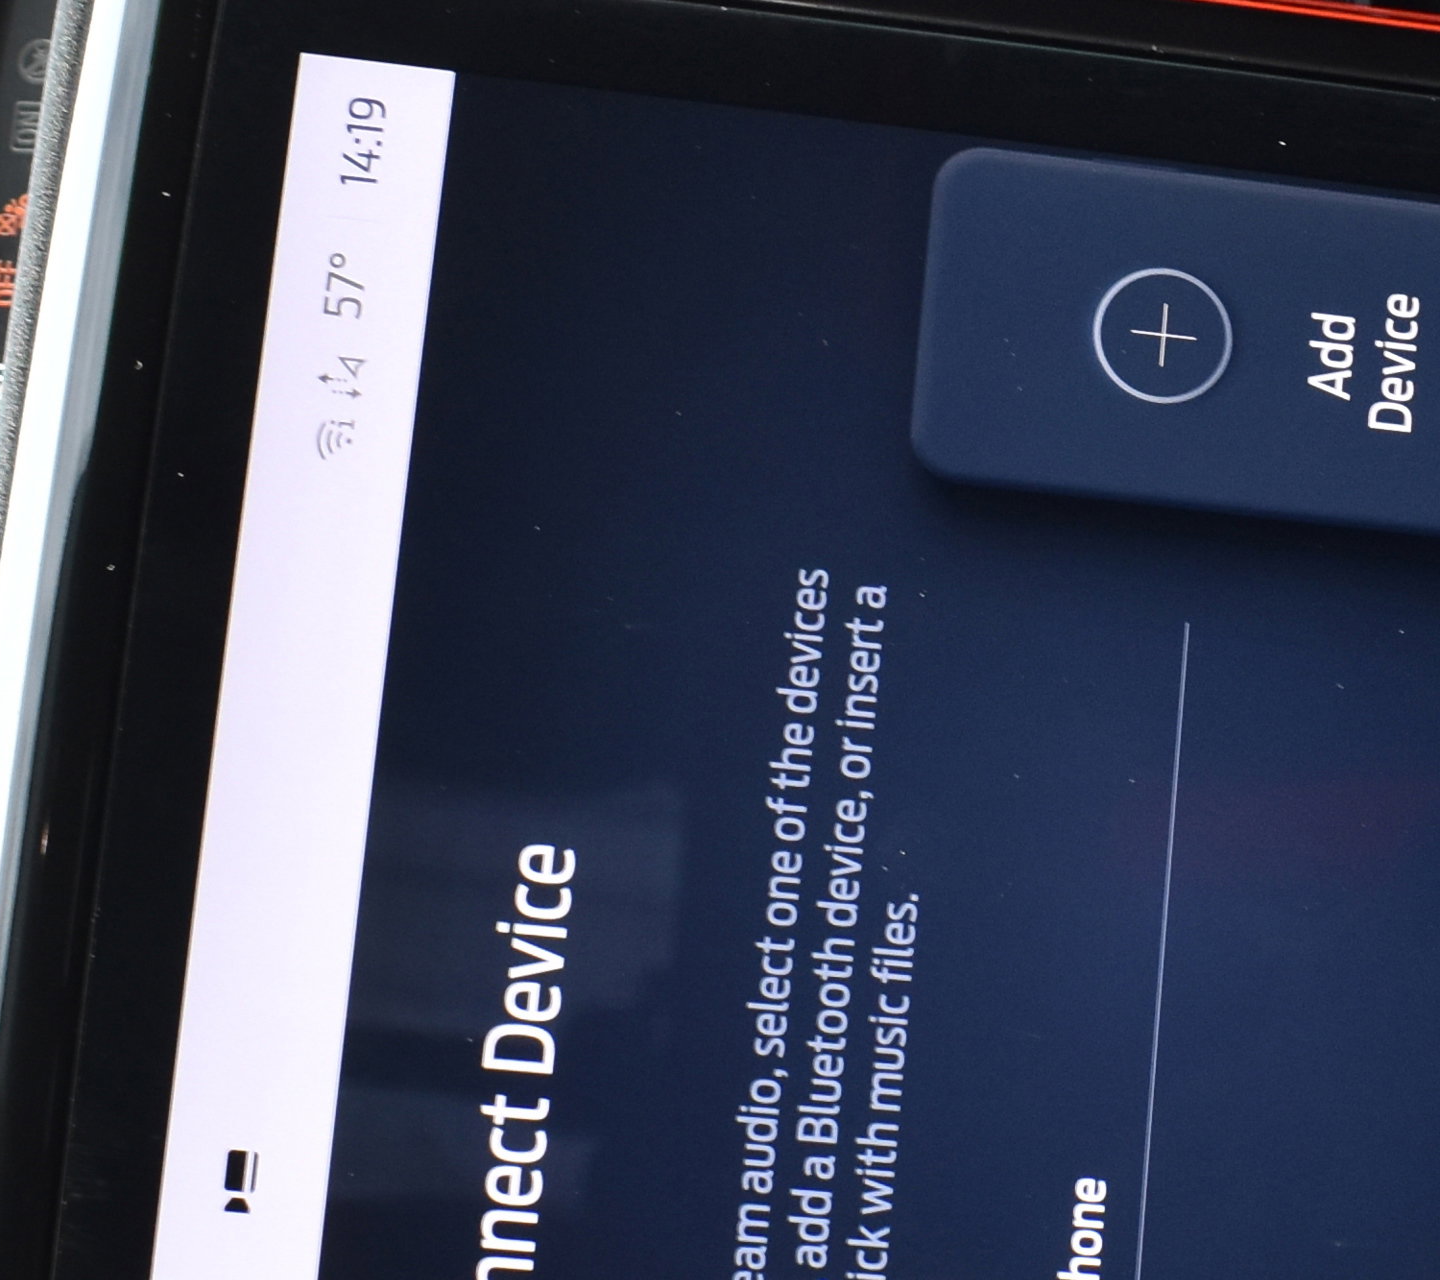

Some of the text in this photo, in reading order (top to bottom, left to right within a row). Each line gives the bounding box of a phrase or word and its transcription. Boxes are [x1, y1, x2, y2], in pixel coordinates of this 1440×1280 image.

[340, 97, 386, 186] 14:19
[1307, 312, 1356, 401] Add
[1366, 293, 1420, 433] Device
[775, 568, 830, 714] devices
[854, 584, 888, 609] a
[835, 617, 884, 730] insert
[768, 722, 815, 790] the
[839, 736, 873, 780] or
[765, 795, 808, 841] of
[815, 790, 874, 927] device,
[764, 851, 803, 927] one
[481, 844, 576, 1075] Device
[870, 892, 920, 984] files.
[744, 936, 796, 1058] select
[796, 937, 856, 1144] Bluetooth
[867, 994, 910, 1112] music
[735, 1067, 789, 1194] audio,
[803, 1155, 836, 1181] a
[853, 1122, 900, 1215] with
[787, 1187, 833, 1269] add
